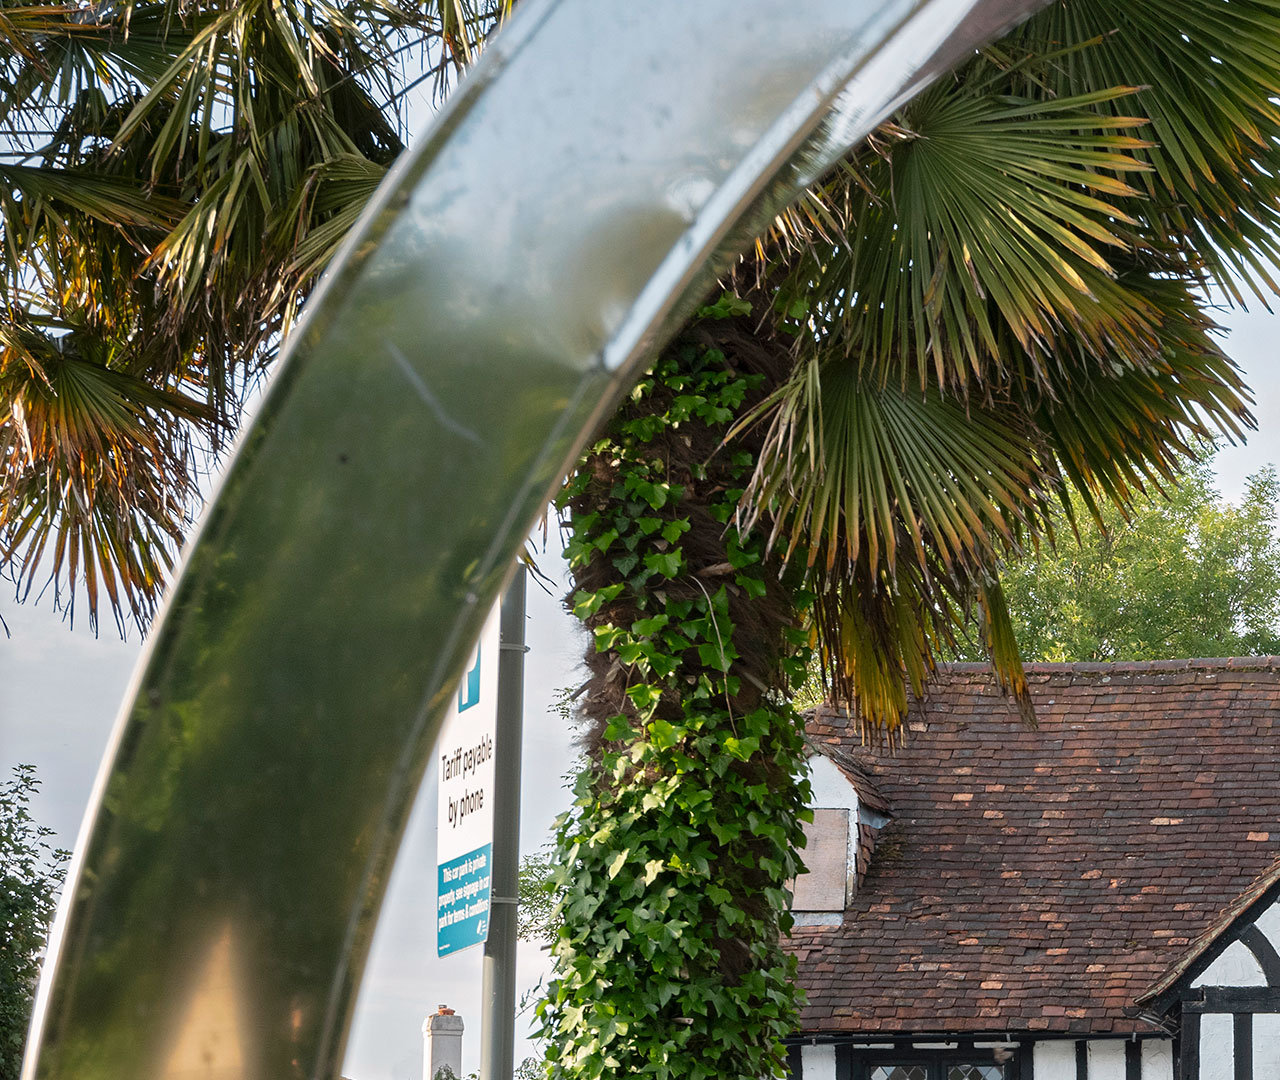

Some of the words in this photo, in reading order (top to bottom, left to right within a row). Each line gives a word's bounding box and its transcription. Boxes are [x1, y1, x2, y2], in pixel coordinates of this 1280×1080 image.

[442, 747, 462, 781] Tariff
[463, 733, 492, 779] payable
[449, 796, 459, 828] by
[459, 788, 483, 825] phone
[443, 867, 452, 883] This
[459, 860, 468, 880] park
[472, 854, 486, 874] private
[463, 882, 478, 900] signage
[439, 912, 447, 932] park
[453, 909, 465, 923] terms
[469, 899, 488, 917] conditions
